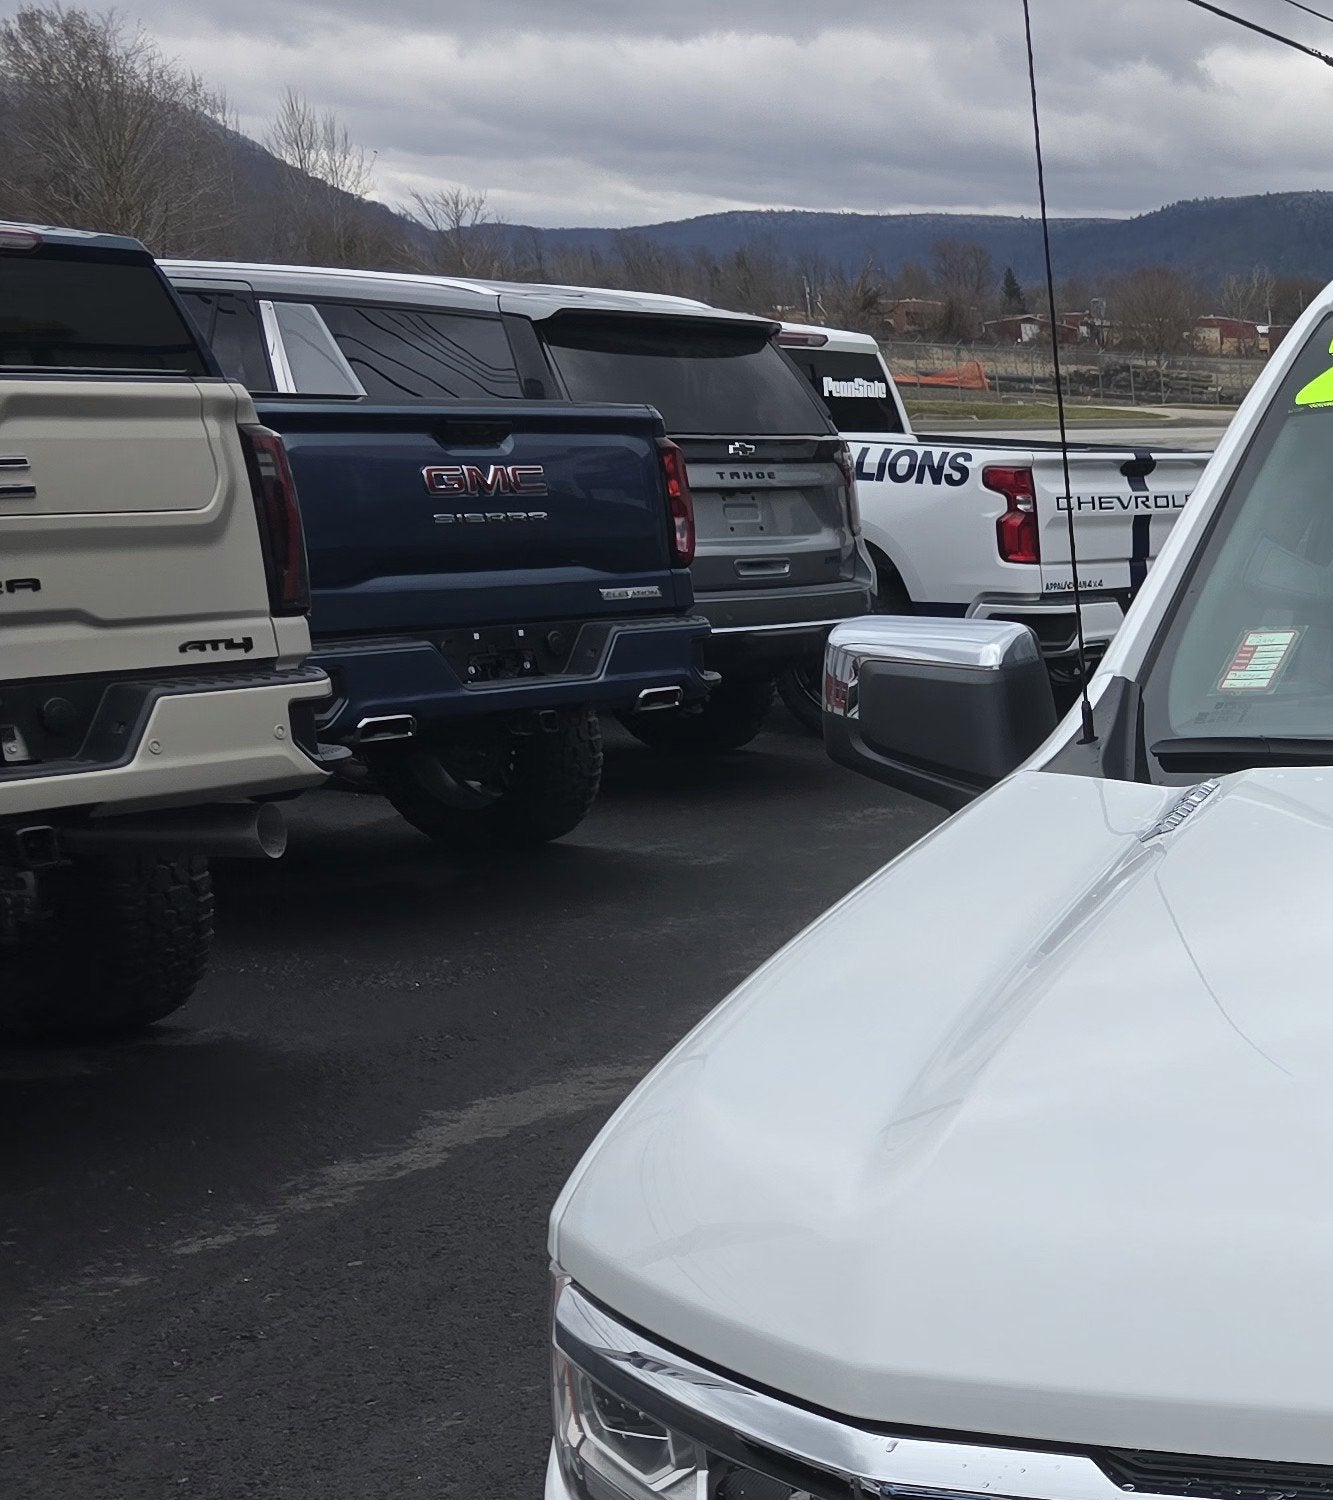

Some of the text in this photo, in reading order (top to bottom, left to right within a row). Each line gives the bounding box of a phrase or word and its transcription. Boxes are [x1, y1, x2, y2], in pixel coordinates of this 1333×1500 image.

[715, 471, 777, 480] TAHOE
[856, 446, 973, 487] LIONS
[420, 464, 549, 498] GMC
[1056, 494, 1191, 512] CHEVROL
[433, 511, 548, 524] SIERRA
[178, 636, 254, 654] AT4
